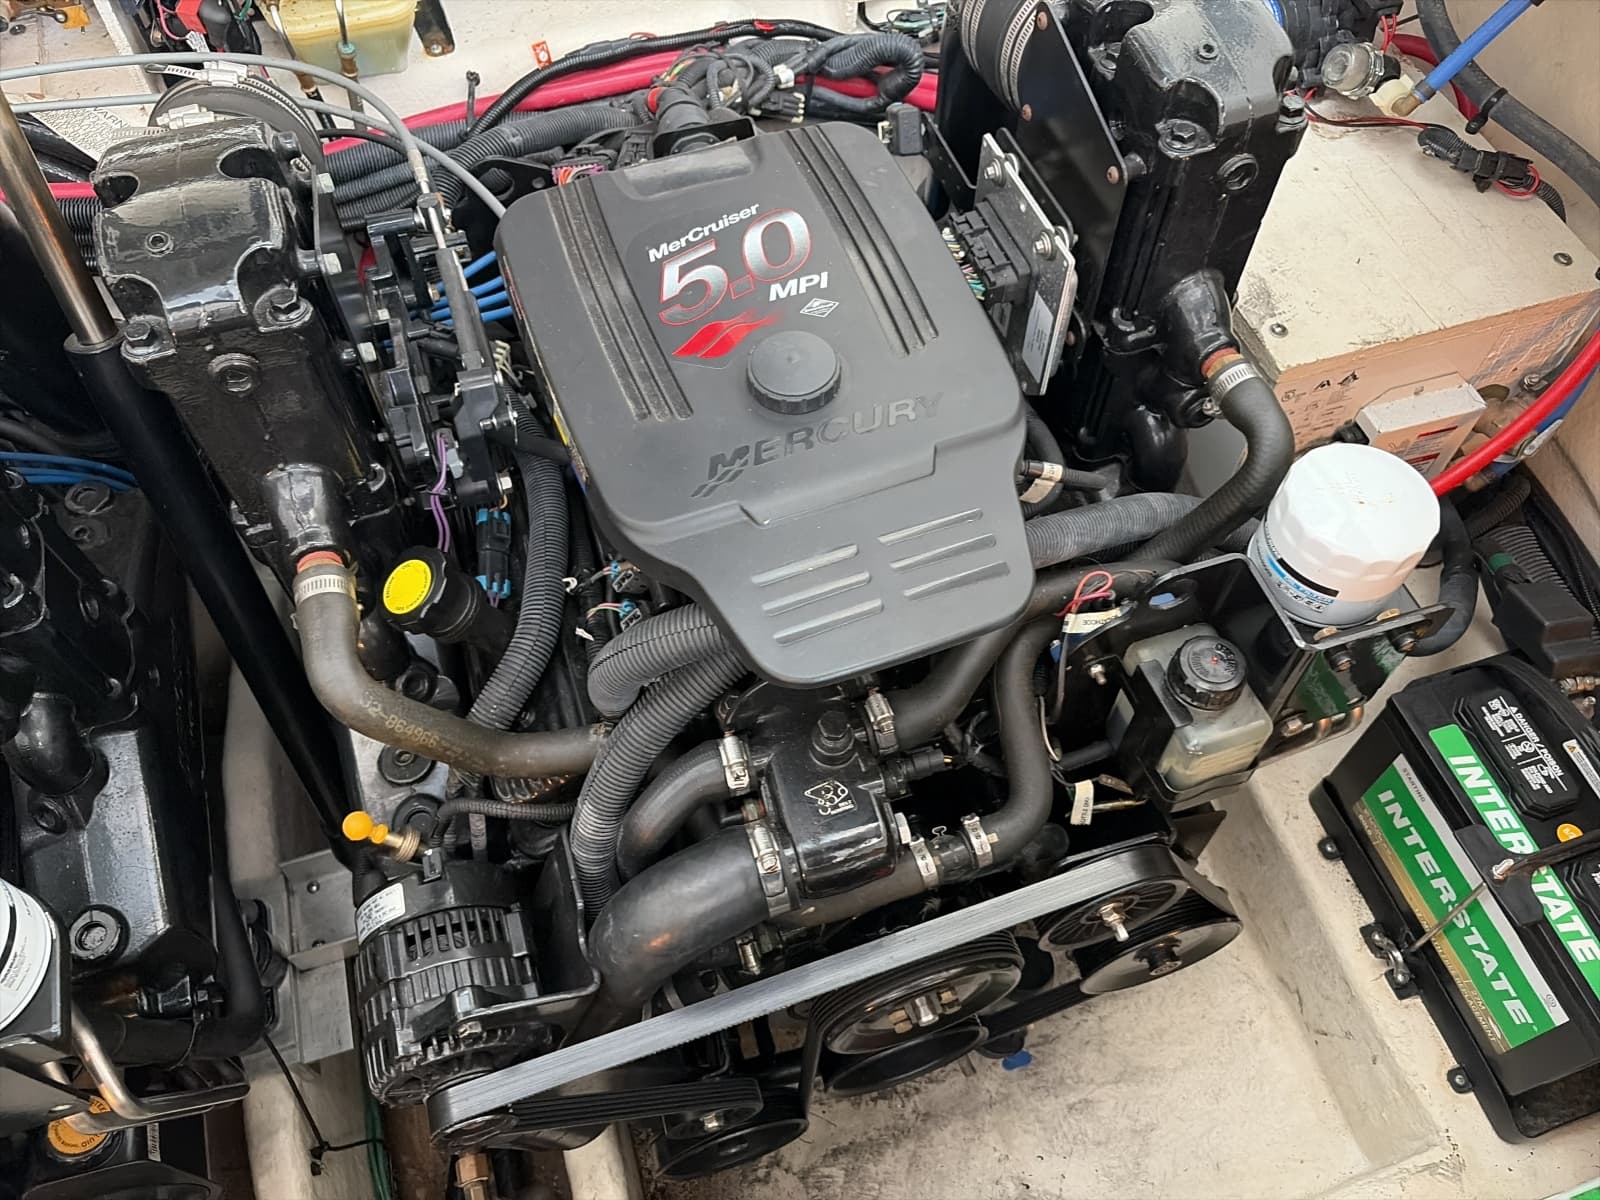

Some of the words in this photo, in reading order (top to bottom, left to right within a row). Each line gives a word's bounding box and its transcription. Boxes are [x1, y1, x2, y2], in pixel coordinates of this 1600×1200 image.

[648, 204, 760, 263] MerCruiser
[658, 207, 812, 326] 5.0
[768, 271, 828, 302] MPI
[690, 391, 945, 498] MERCURY
[1402, 767, 1426, 804] STARTING
[1514, 712, 1541, 743] DANGER
[1540, 748, 1565, 777] POISON
[1449, 755, 1600, 964] INTERTATE
[1377, 789, 1532, 1026] INTERSTATE
